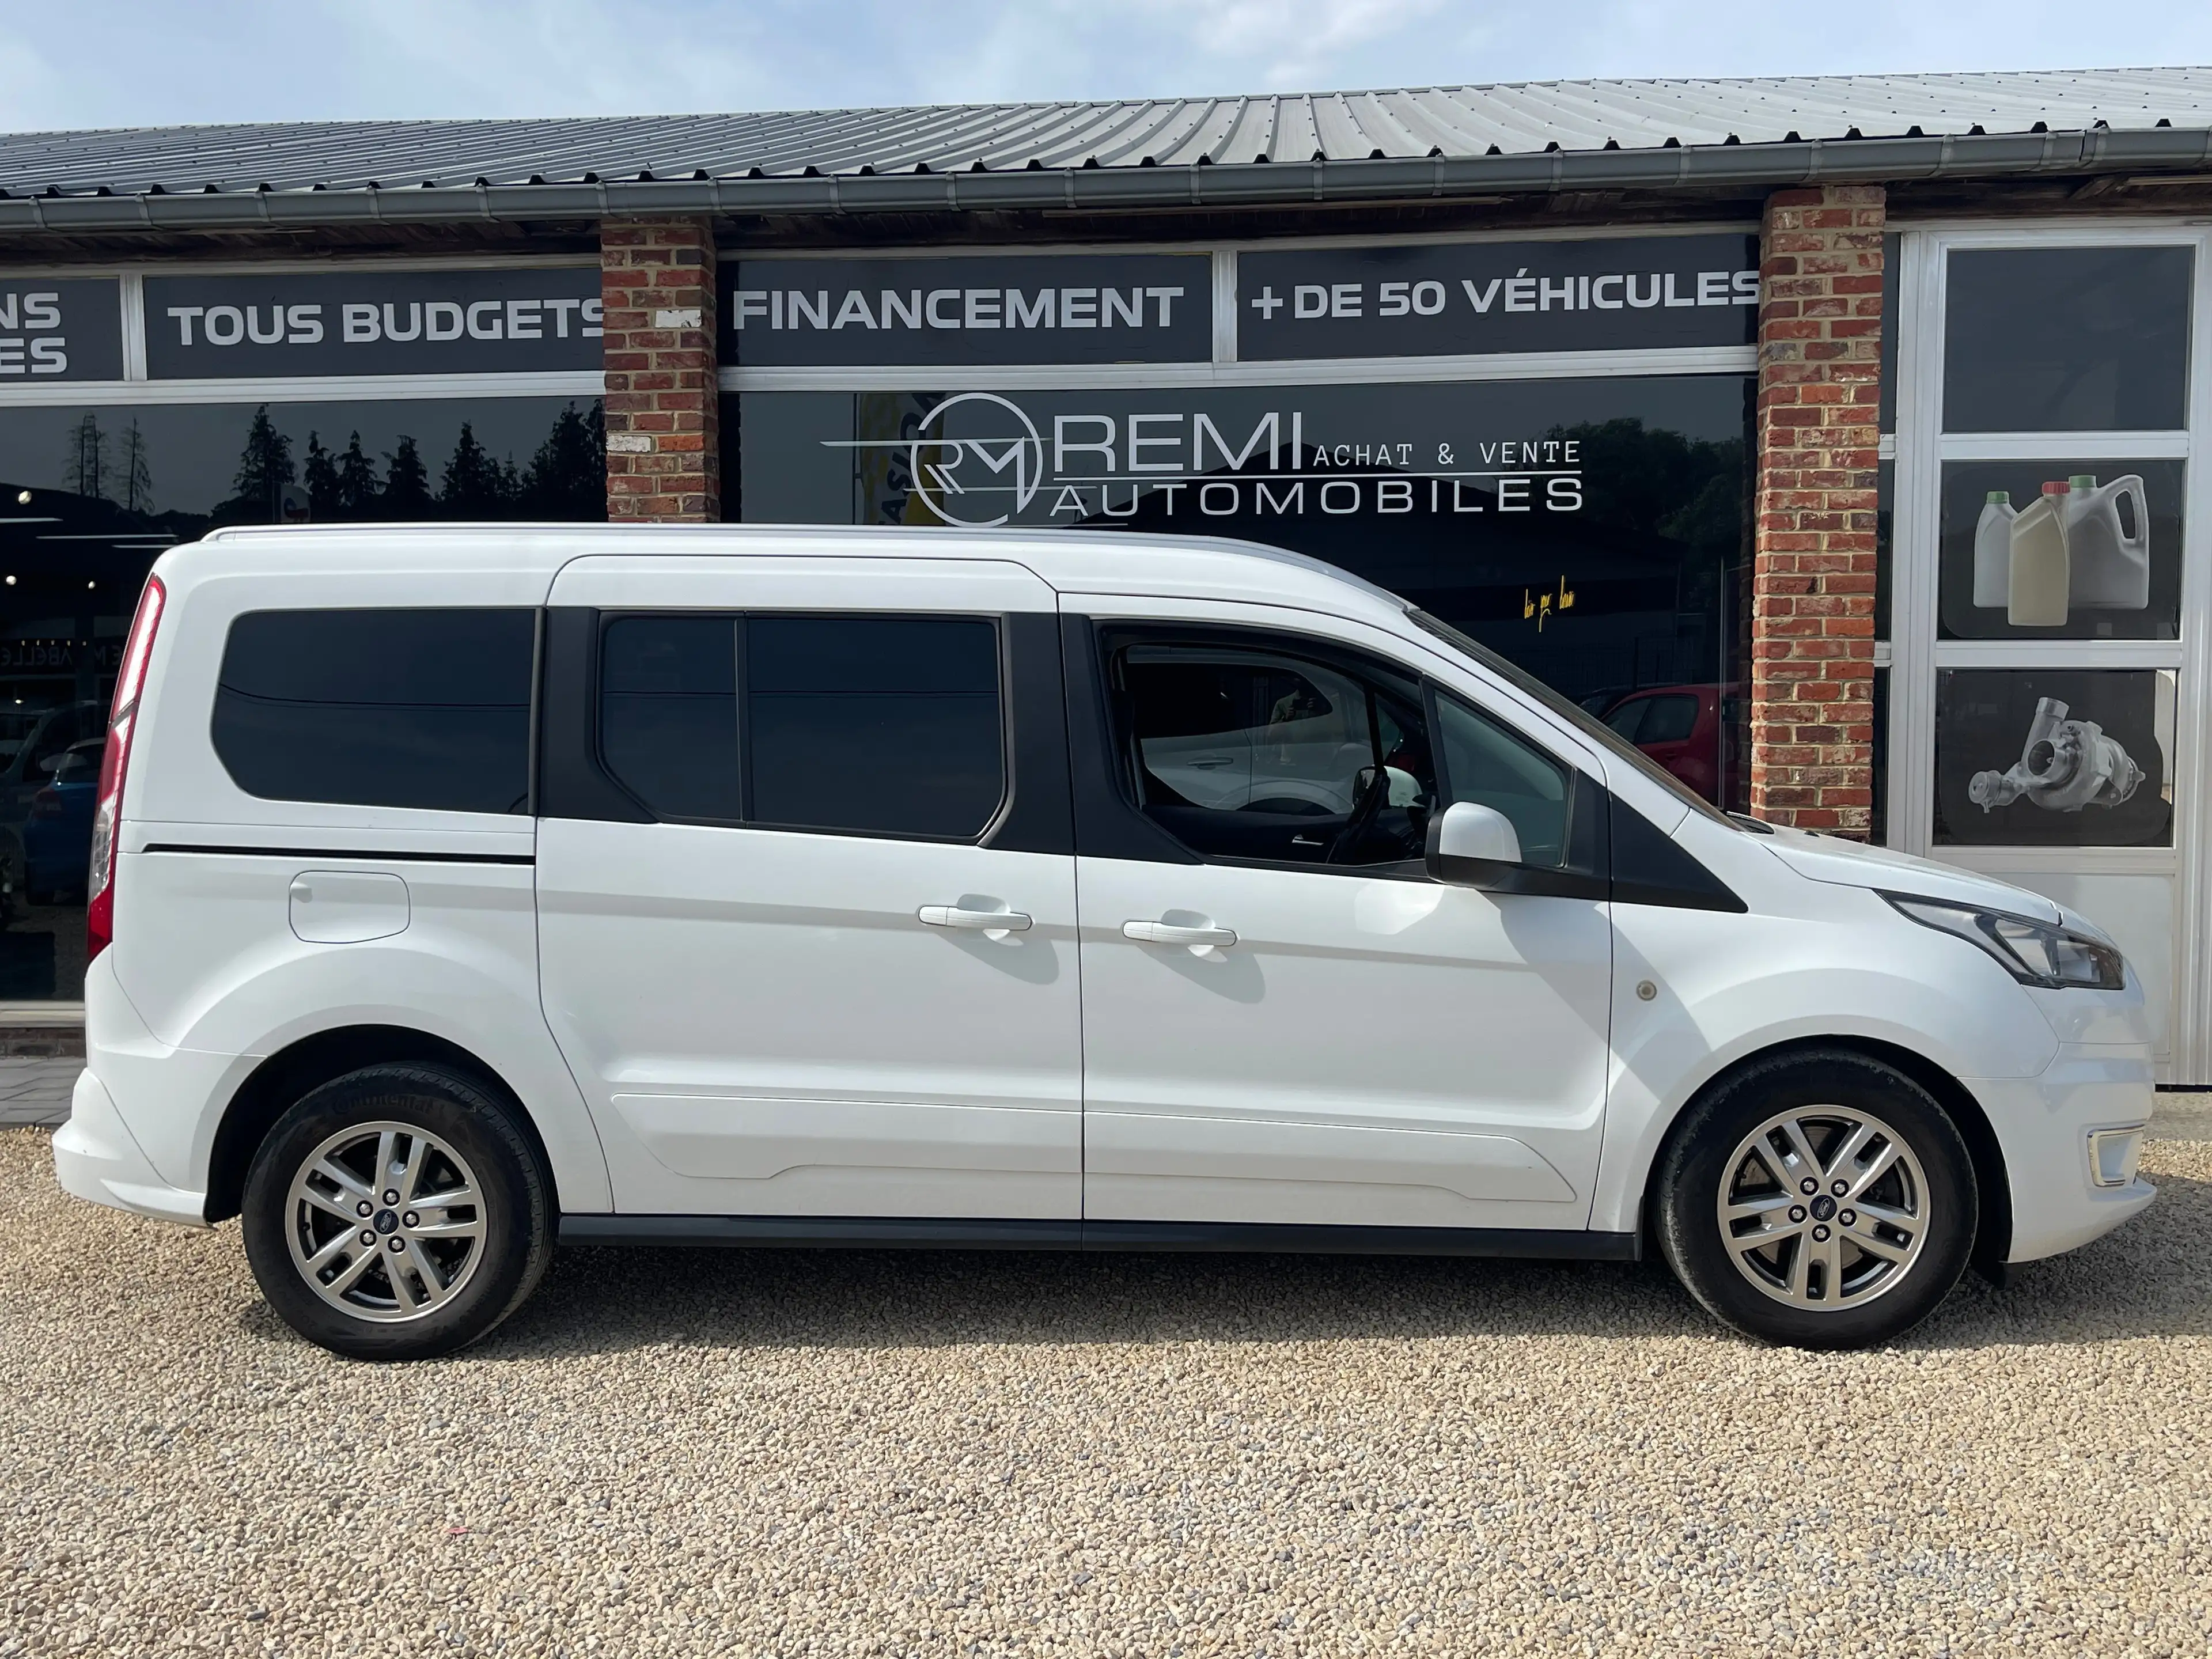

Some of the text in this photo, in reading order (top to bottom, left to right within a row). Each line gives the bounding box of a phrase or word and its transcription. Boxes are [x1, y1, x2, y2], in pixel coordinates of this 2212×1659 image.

[734, 287, 1184, 329] FINANCEMENT
[1294, 283, 1362, 319] DE
[1379, 281, 1446, 316] 50
[1461, 267, 1760, 313] VÉHICULES
[167, 298, 604, 345] TOUS BUDGETS
[1054, 411, 1302, 472] REMI
[1313, 441, 1580, 467] ACHAT & VENTE
[1050, 477, 1583, 517] AUTOMOBILES
